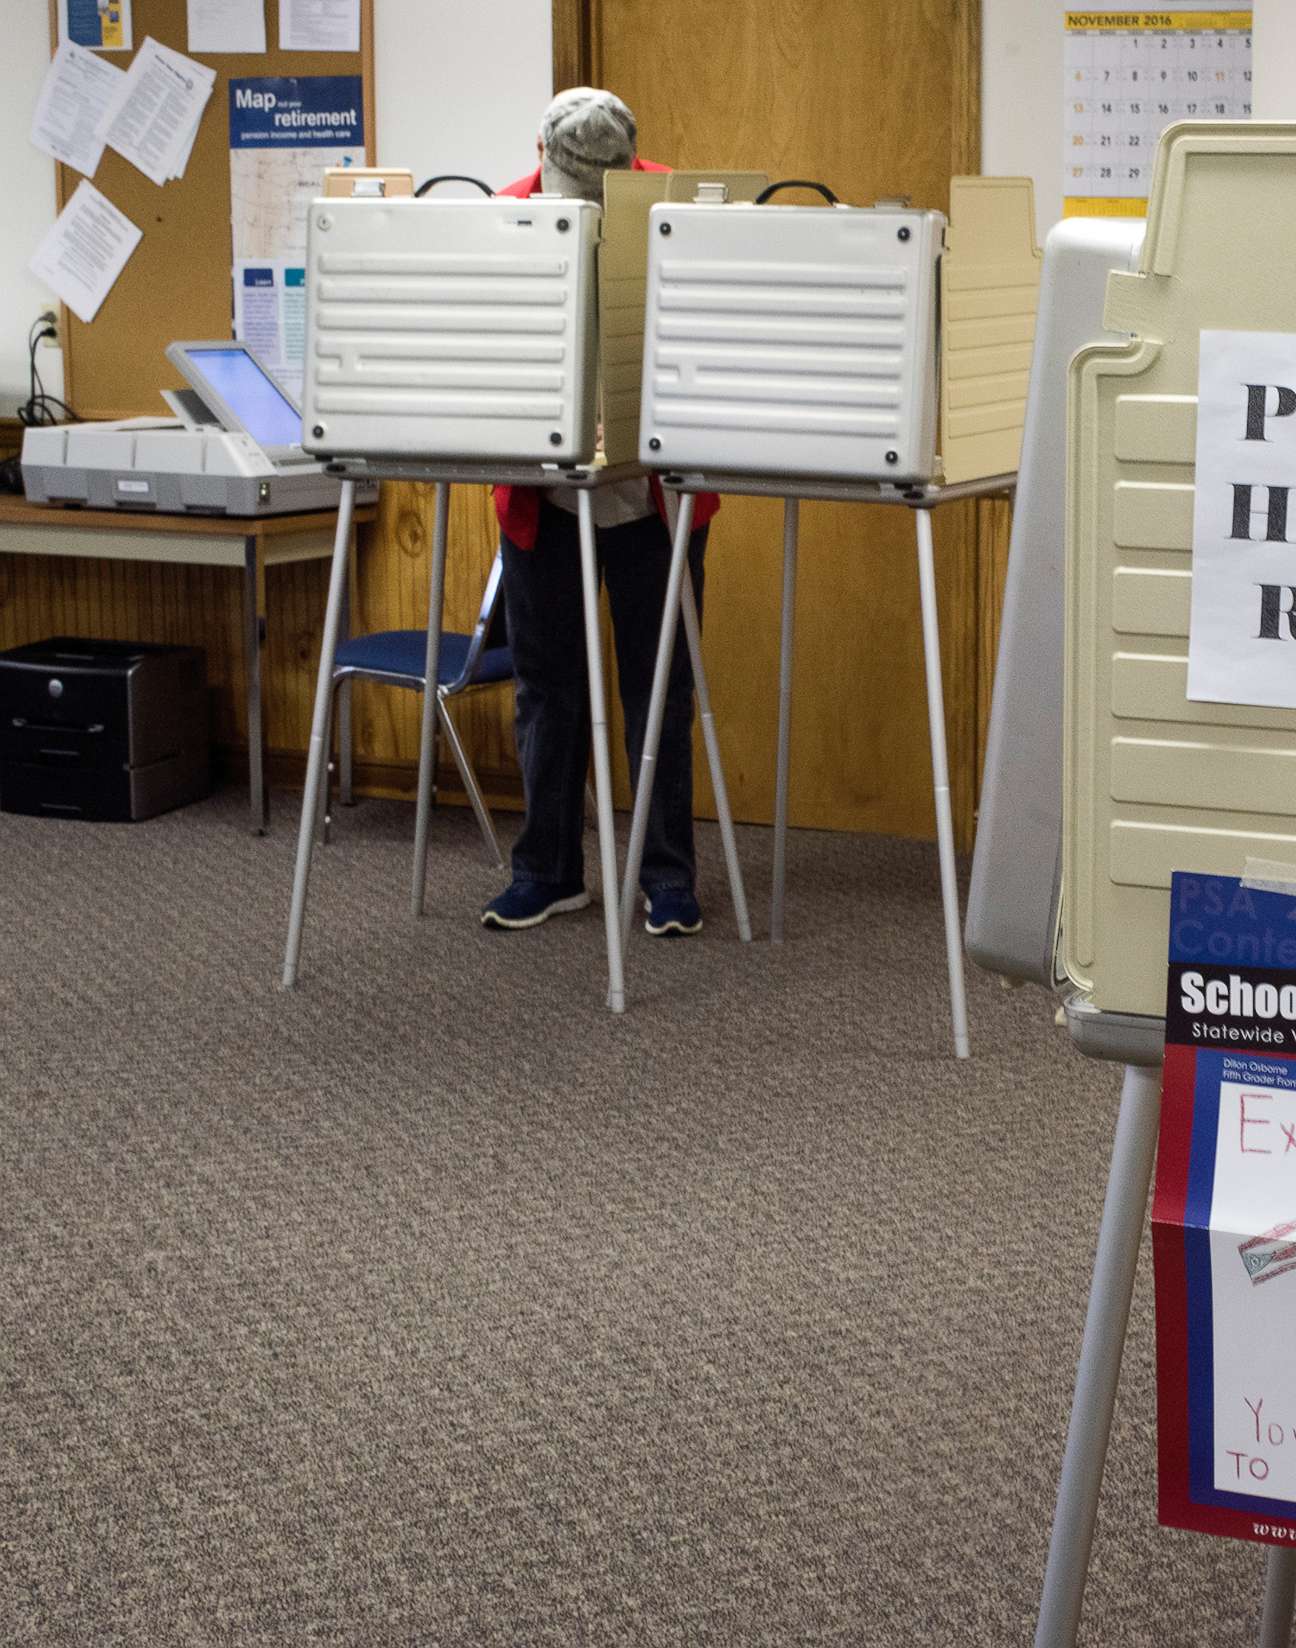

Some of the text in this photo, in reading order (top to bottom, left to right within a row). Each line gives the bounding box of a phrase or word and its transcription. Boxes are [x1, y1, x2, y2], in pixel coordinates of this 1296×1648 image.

[1068, 15, 1139, 26] NOVEMBER
[1144, 15, 1172, 26] 2016
[1161, 38, 1168, 48] 2
[1189, 38, 1196, 48] 3
[1217, 38, 1224, 48] 4
[1104, 71, 1110, 81] 7
[1132, 71, 1138, 81] 8
[1160, 71, 1167, 81] 9
[1187, 71, 1198, 81] 10
[1215, 71, 1225, 81] 11
[235, 88, 276, 112] Map
[1101, 104, 1112, 114] 14
[1130, 104, 1140, 114] 15
[1158, 104, 1169, 114] 16
[1187, 104, 1198, 114] 17
[1215, 104, 1225, 114] 18
[274, 109, 357, 127] retirement
[270, 131, 298, 139] income
[299, 130, 311, 138] and
[313, 129, 334, 138] health
[335, 130, 351, 138] care
[1072, 136, 1140, 146] 20 21 22
[1072, 168, 1140, 178] 27 28 29
[1180, 878, 1257, 920] PSA
[1192, 1021, 1284, 1044] Statewide
[1224, 1057, 1288, 1075] Dillon Osborne
[1223, 1069, 1241, 1080] Fifth
[1243, 1071, 1276, 1084] Grader
